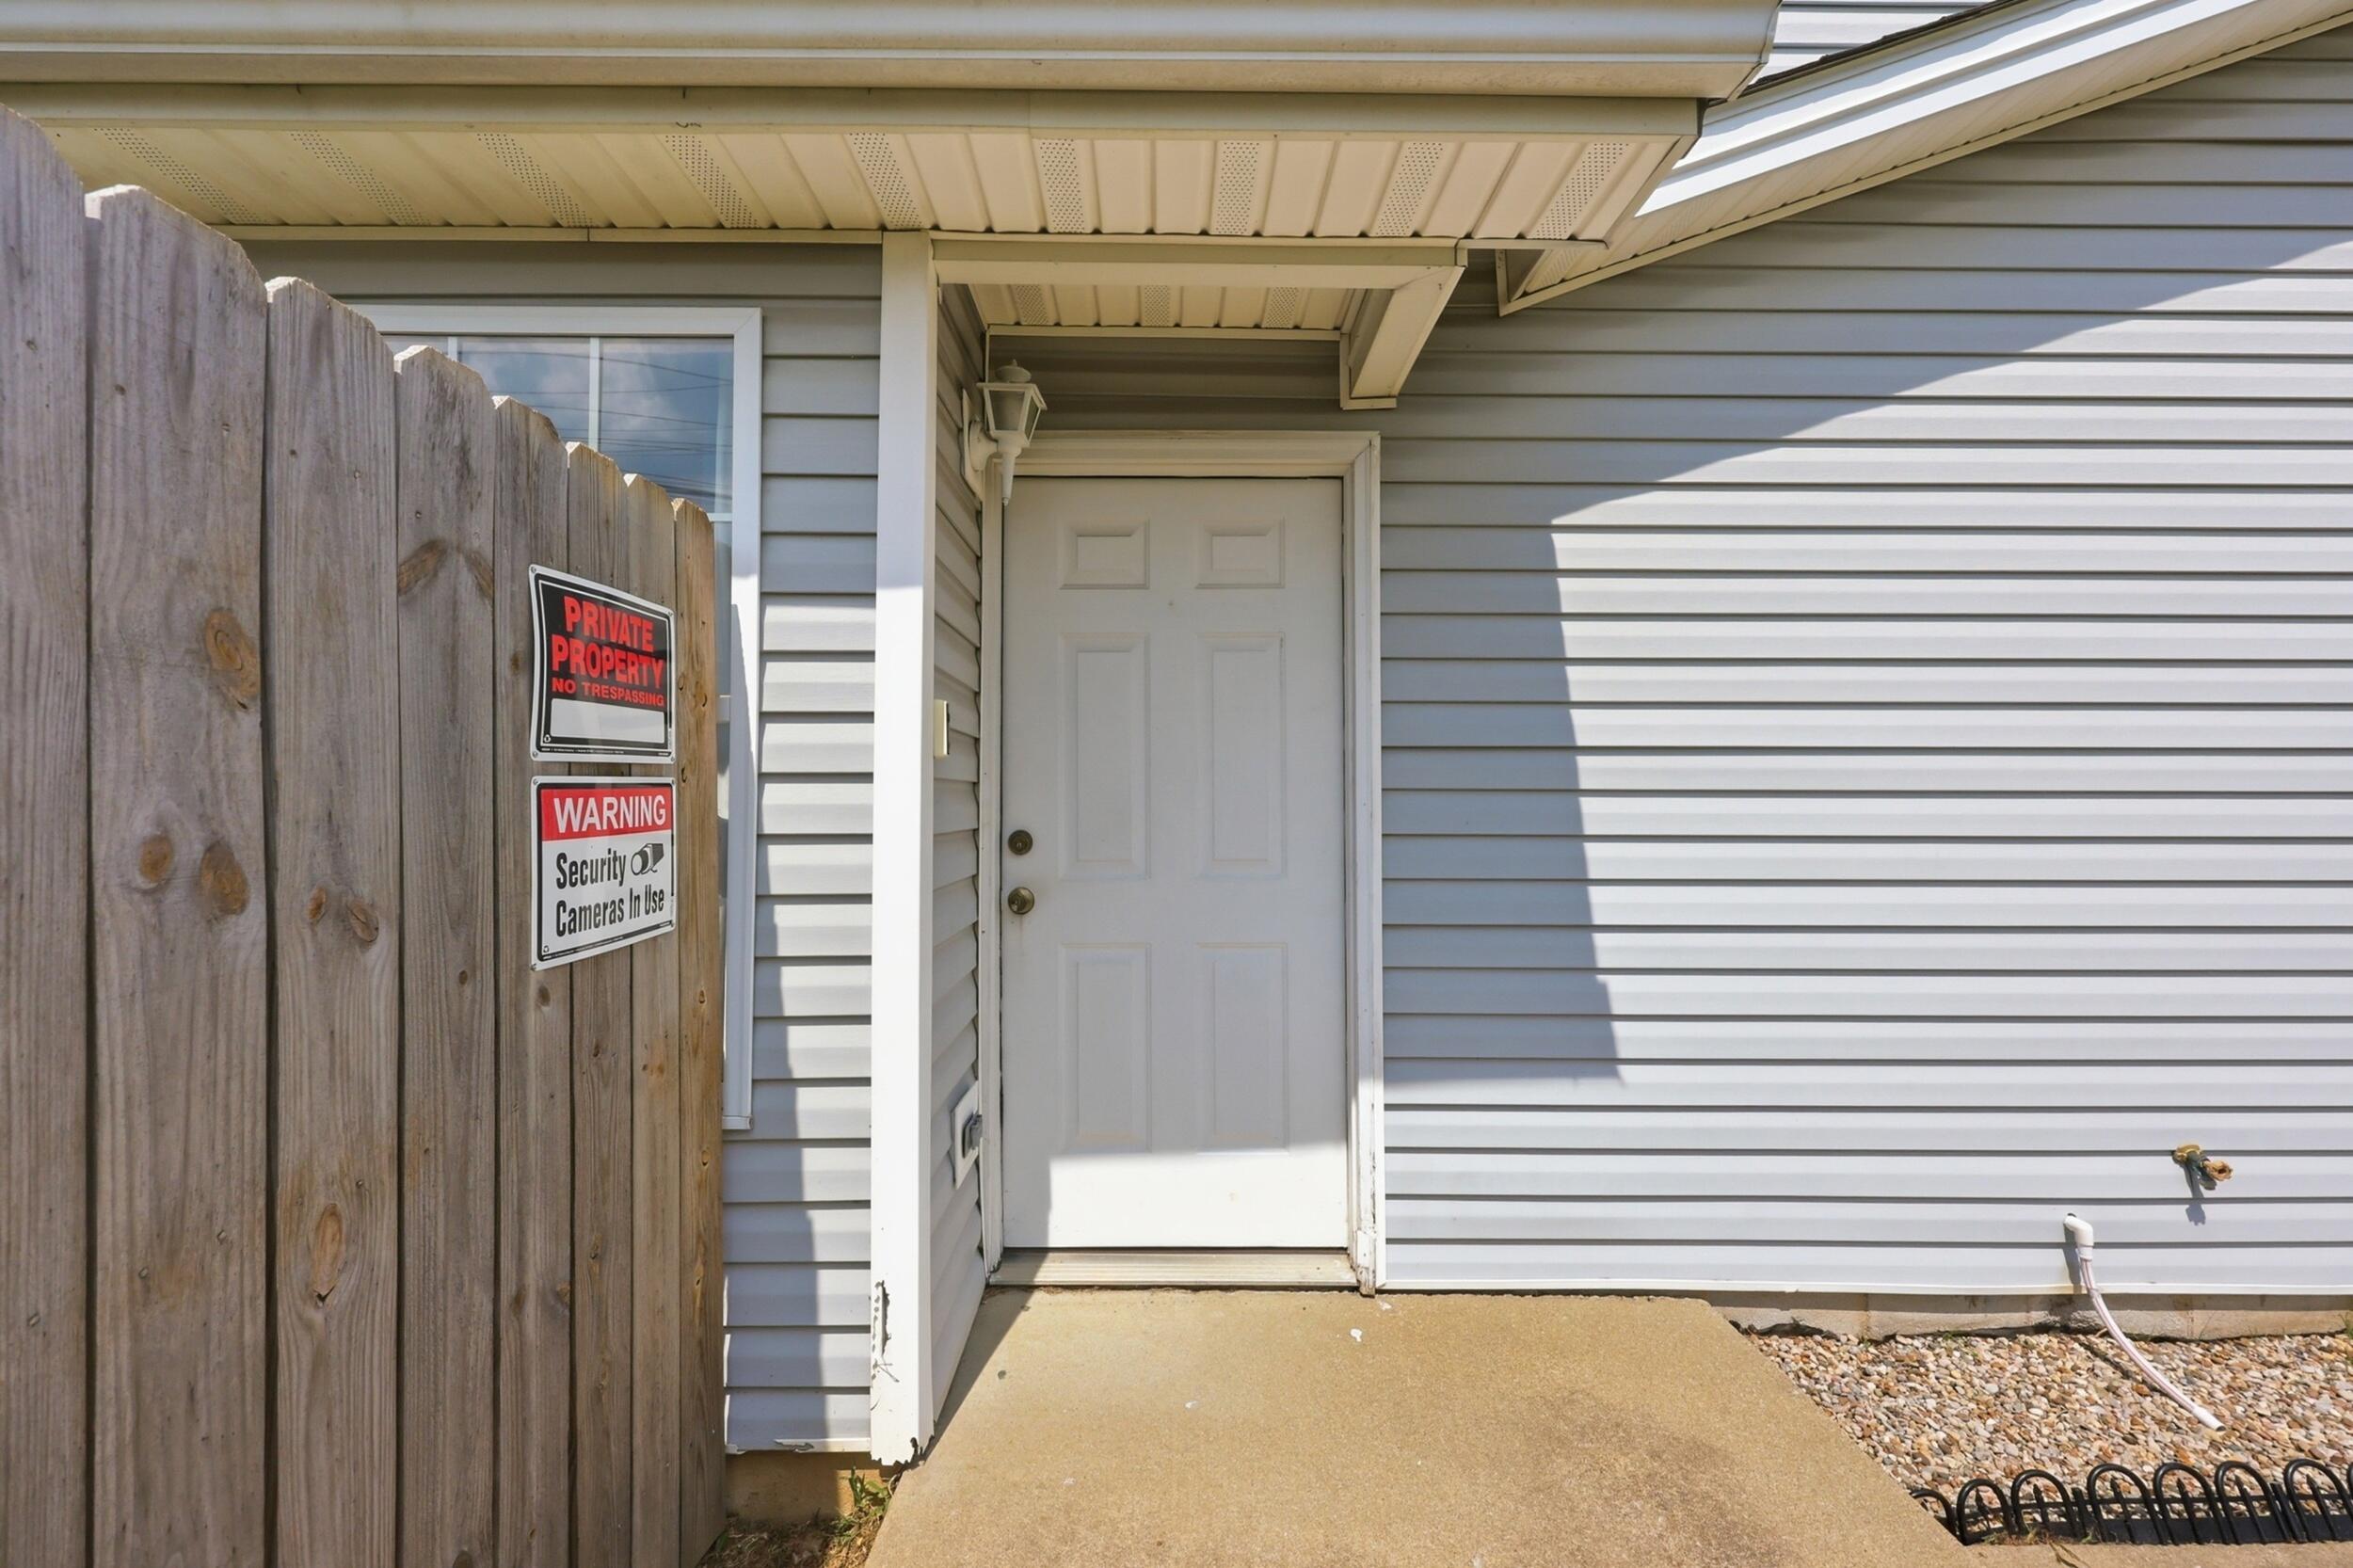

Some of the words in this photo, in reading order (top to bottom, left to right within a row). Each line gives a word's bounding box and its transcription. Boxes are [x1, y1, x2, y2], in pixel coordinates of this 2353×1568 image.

[564, 596, 654, 652] PRIVATE
[552, 634, 664, 689] PROPERTY
[552, 678, 576, 694] NO
[582, 681, 664, 706] TRESPASSING
[553, 794, 666, 833] WARNING
[556, 848, 626, 887] Security
[556, 895, 624, 936] Cameras
[629, 888, 640, 920] In
[645, 884, 664, 915] Use
